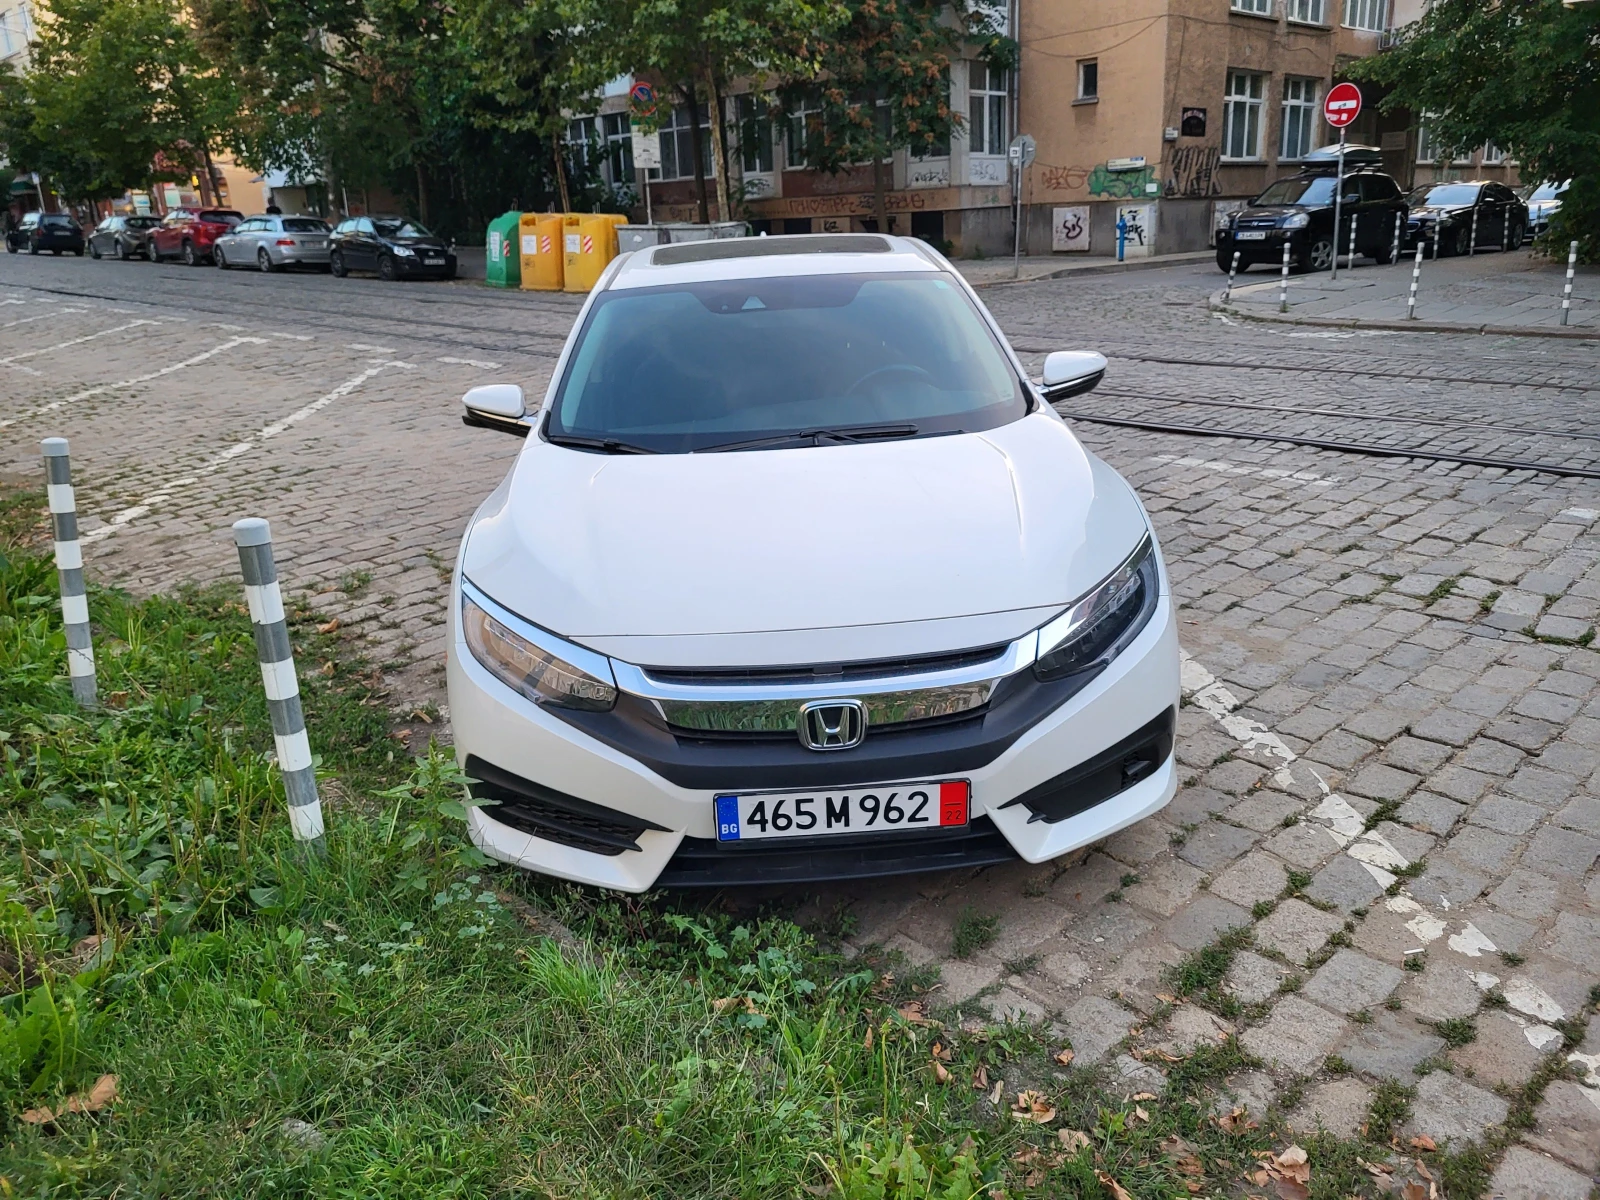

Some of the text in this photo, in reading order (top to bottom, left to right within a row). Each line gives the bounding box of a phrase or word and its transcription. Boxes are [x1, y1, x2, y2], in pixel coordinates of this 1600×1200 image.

[746, 790, 930, 833] 465 M 962
[945, 809, 963, 821] 22
[721, 823, 738, 834] BG
